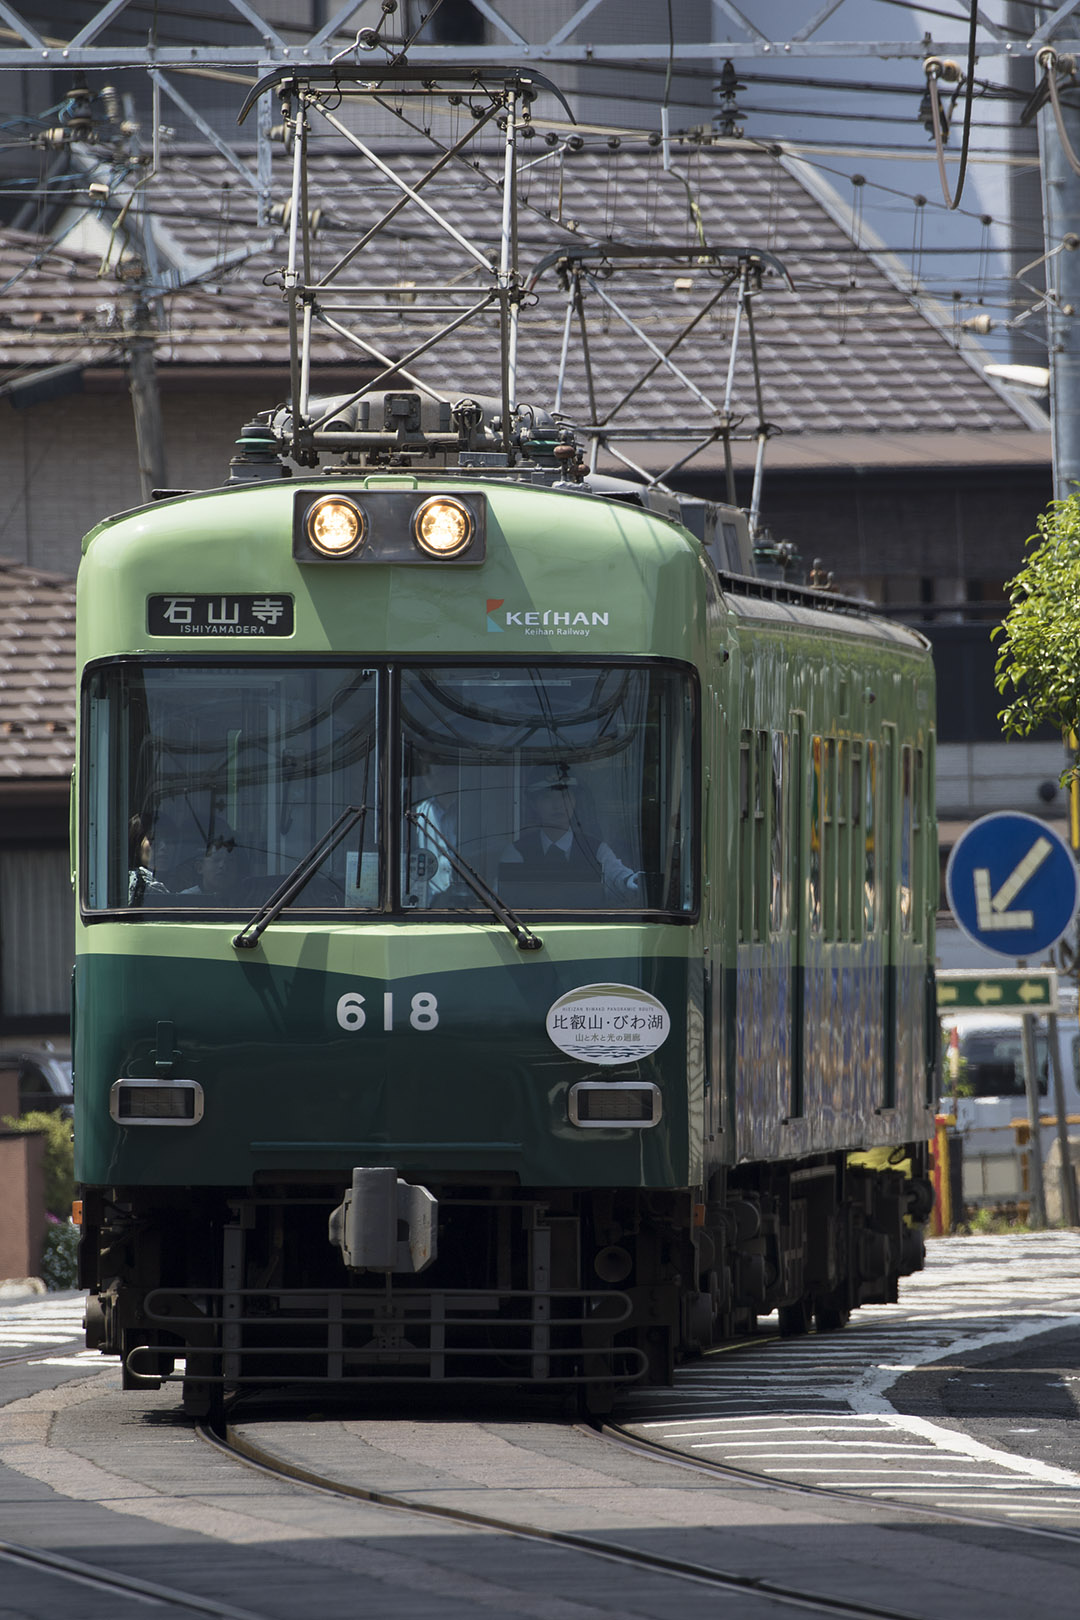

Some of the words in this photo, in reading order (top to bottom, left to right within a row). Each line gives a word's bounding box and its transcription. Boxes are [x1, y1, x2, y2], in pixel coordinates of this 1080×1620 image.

[163, 597, 284, 624] 石山寺
[506, 610, 609, 626] KEIHAN
[180, 625, 265, 634] ISHIYAMADERA
[525, 628, 554, 636] Keihan
[556, 628, 590, 637] Railway
[336, 992, 439, 1031] 618
[553, 1014, 663, 1030] 比叡山・びわ湖
